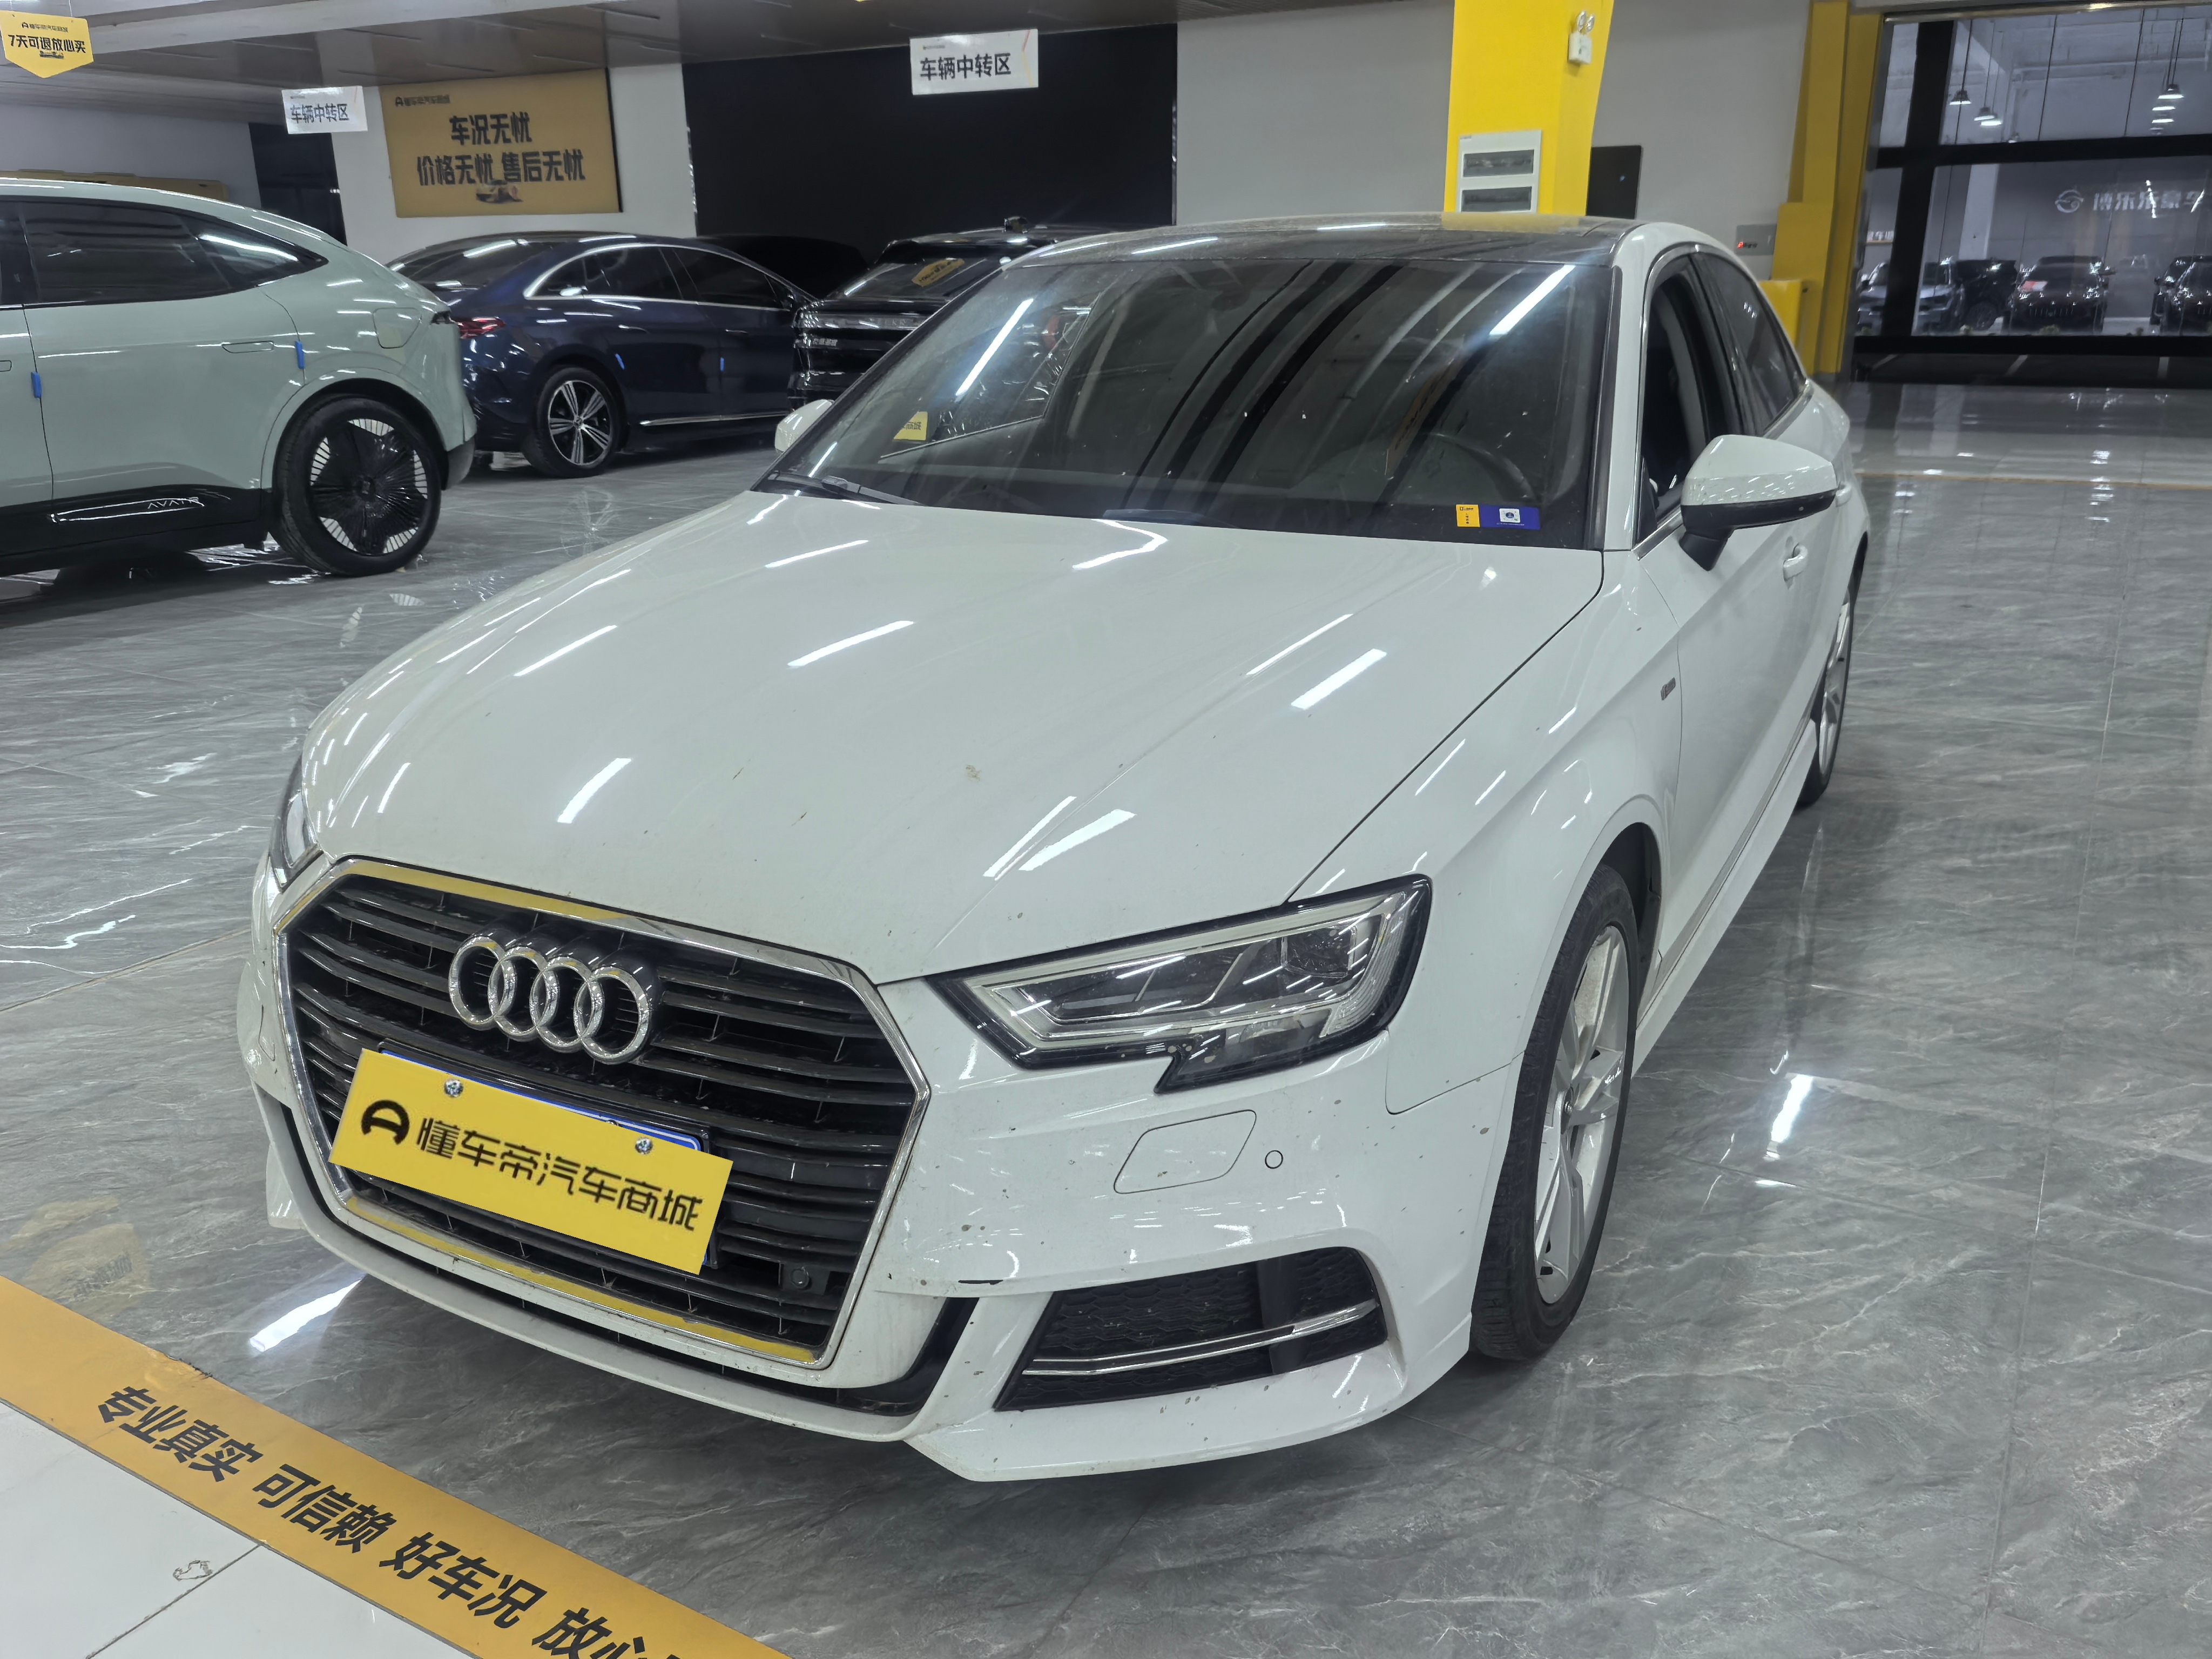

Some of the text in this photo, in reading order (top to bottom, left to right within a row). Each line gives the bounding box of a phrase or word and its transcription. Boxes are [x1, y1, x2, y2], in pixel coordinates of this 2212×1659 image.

[8, 35, 86, 53] 7天可退放心买
[920, 53, 1011, 80] 车辆中转区
[291, 103, 349, 124] 车辆中转区
[449, 112, 532, 145] 车况无忧
[417, 149, 586, 186] 价格无忧 售后无忧
[98, 1386, 264, 1482] 专业真实
[252, 1464, 397, 1554] 可信赖
[380, 1532, 548, 1629] 好车况
